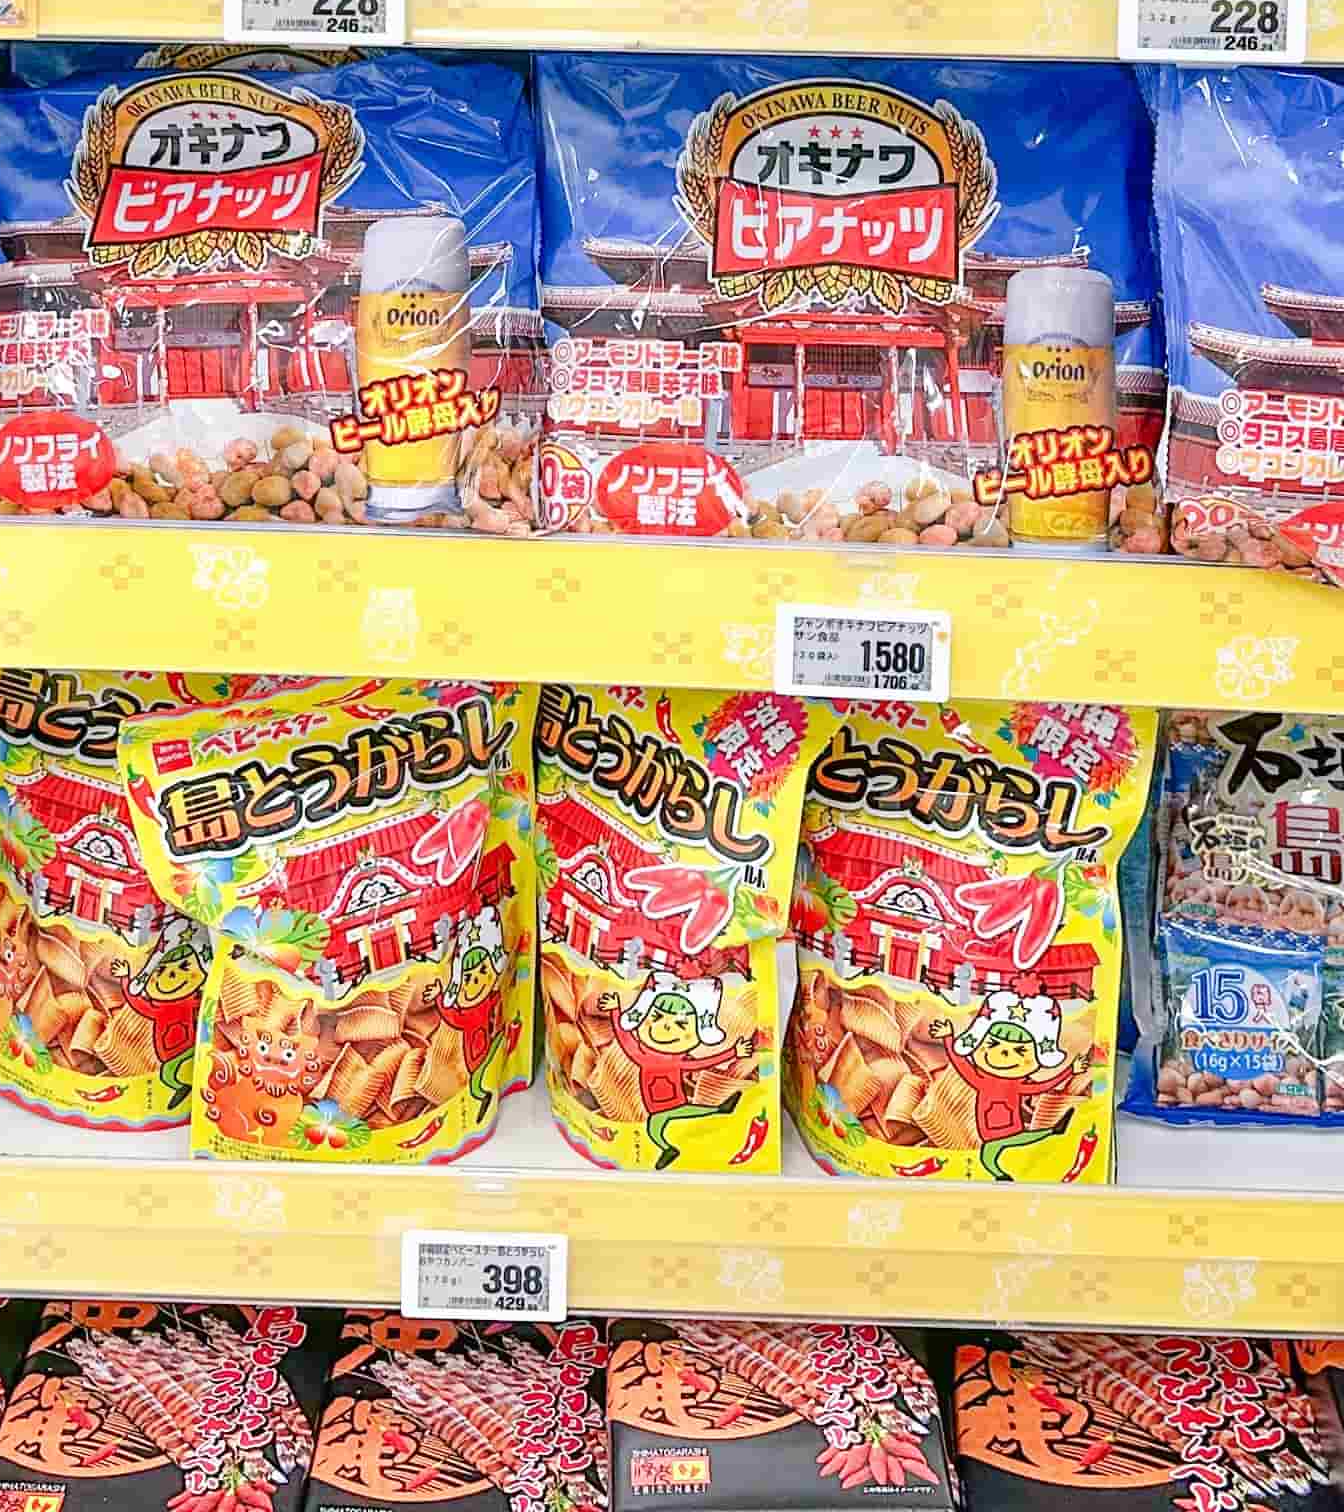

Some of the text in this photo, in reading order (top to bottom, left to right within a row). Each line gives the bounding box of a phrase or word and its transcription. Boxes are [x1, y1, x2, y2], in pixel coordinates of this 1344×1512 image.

[126, 83, 196, 118] OKINAWA
[199, 82, 237, 101] BEER
[741, 92, 828, 131] OKINAWA
[831, 91, 881, 114] BEER
[149, 123, 293, 166] オキナワ
[757, 139, 916, 185] オキナワ
[112, 168, 312, 235] ビアナッツ
[730, 196, 945, 264] ビアナッツ
[361, 371, 465, 413] オリオン
[333, 390, 500, 453] ビール酵母入り
[1009, 428, 1110, 462] オリオン
[18, 462, 79, 492] 製法
[977, 449, 1152, 502] ビール酵母入り
[794, 632, 840, 643] サン食品
[199, 706, 329, 759] ベビースター
[1033, 718, 1101, 781] 限定
[166, 692, 516, 856] 島とうがらし
[1190, 967, 1247, 1024] 15
[482, 1263, 543, 1295] 398
